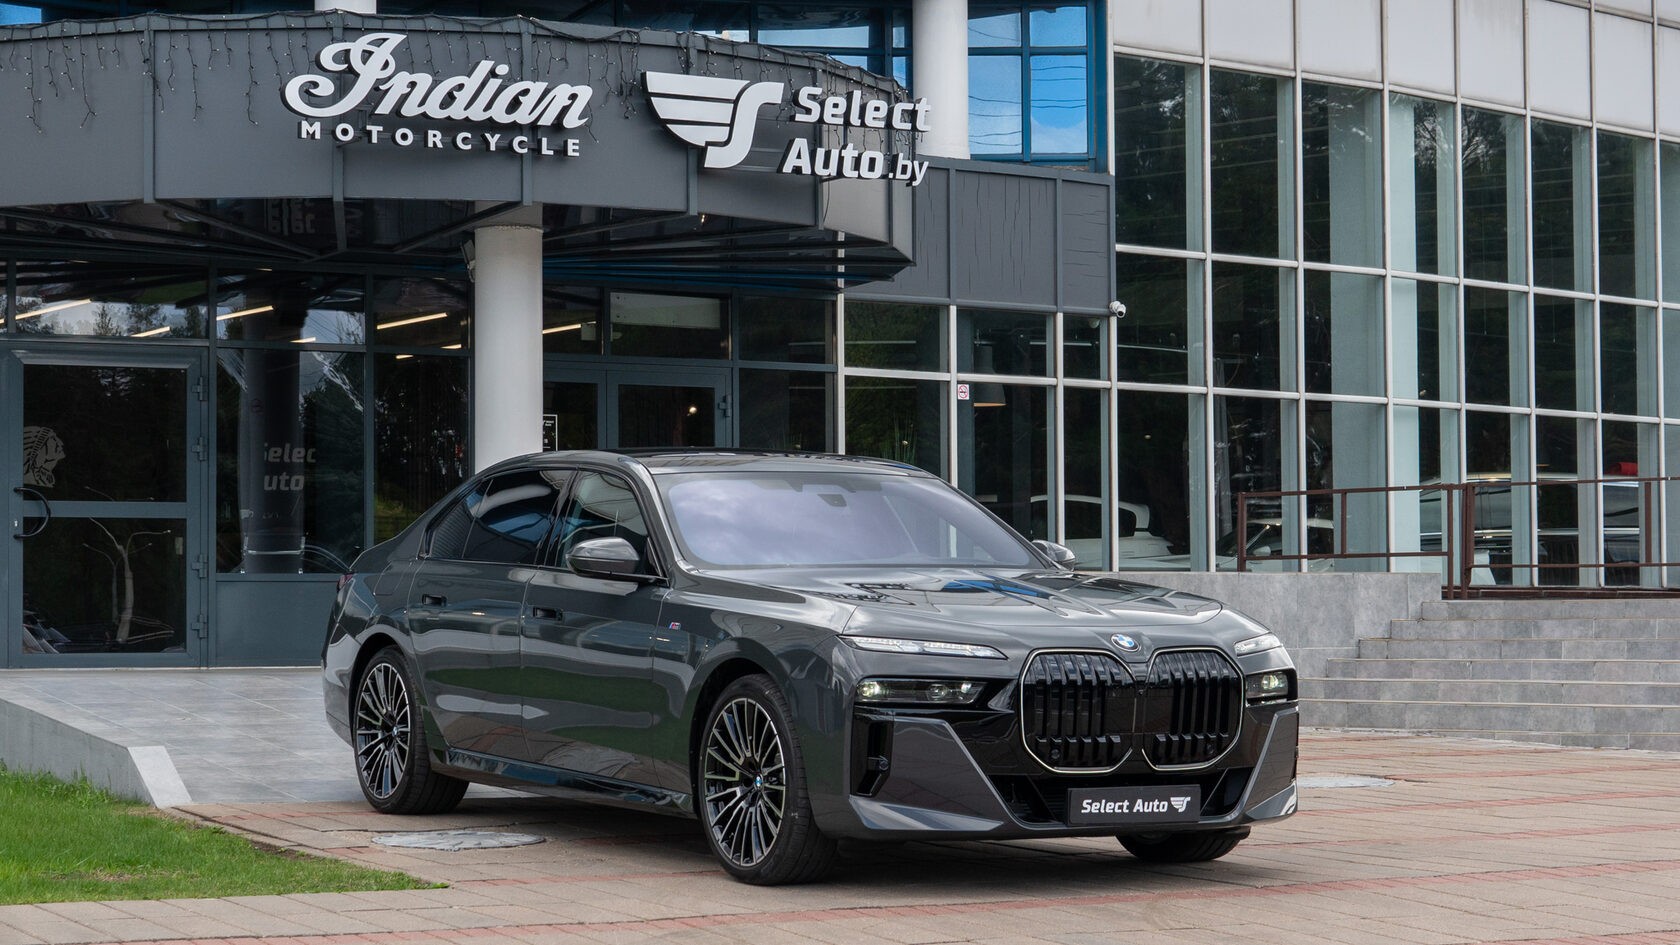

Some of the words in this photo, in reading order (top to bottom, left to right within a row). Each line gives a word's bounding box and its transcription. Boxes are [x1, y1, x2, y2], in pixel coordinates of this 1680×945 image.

[285, 32, 593, 129] Indian
[794, 86, 932, 132] Select
[300, 119, 580, 157] MOTORCYCLE
[782, 137, 930, 187] Auto.by
[1081, 798, 1130, 814] Select
[1133, 798, 1169, 813] Auto
